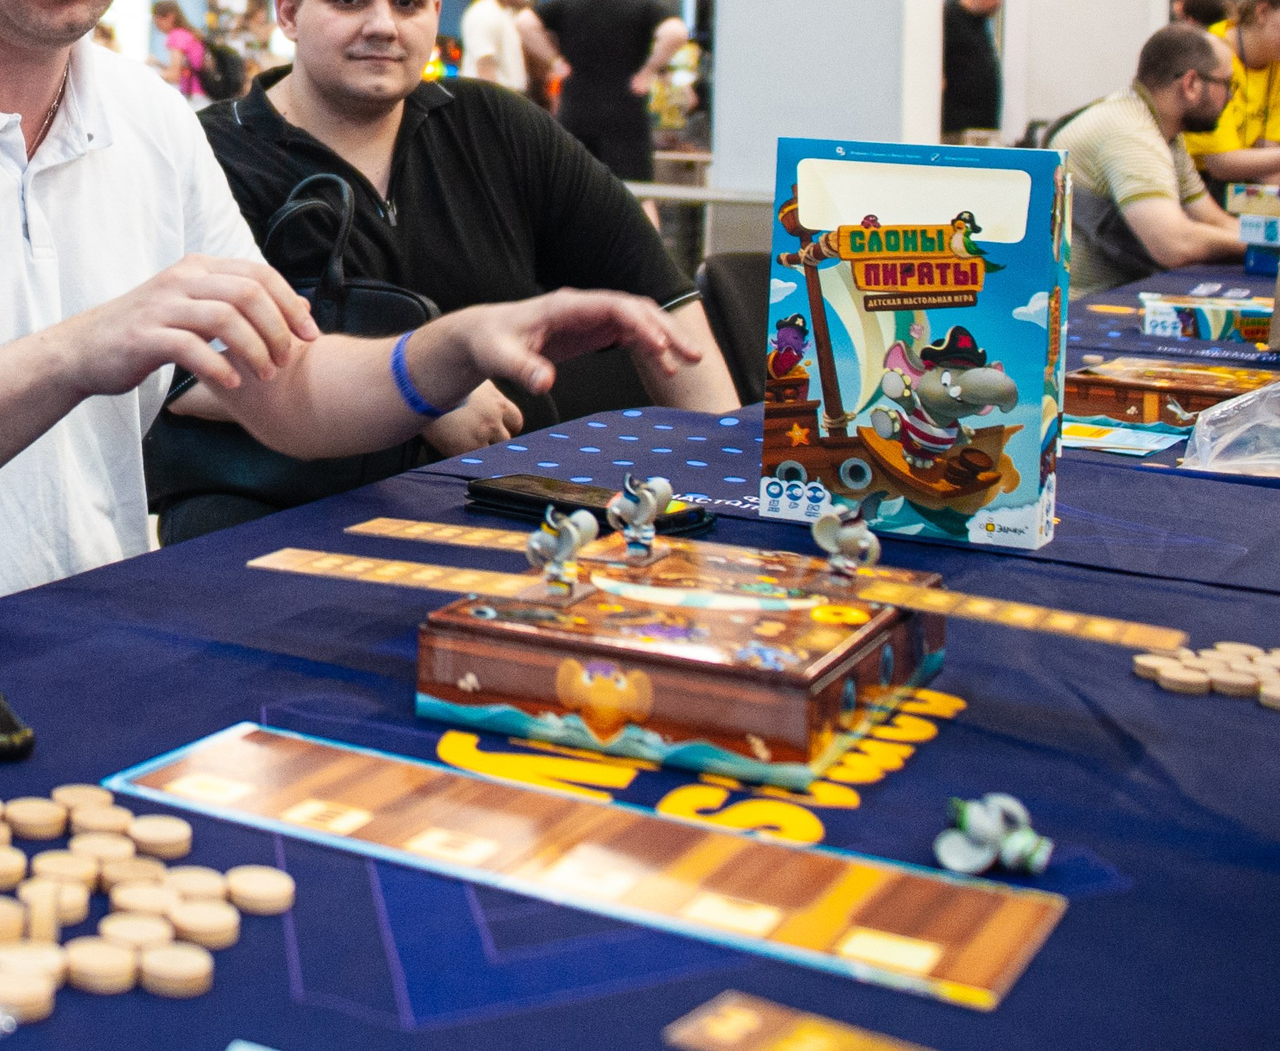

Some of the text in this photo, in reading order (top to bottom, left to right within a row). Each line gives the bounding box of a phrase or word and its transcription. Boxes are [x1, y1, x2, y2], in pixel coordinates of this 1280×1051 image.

[849, 229, 945, 253] СЛОНЫ
[864, 262, 979, 286] ПИРАТЫ
[867, 294, 974, 308] ДЕТСКАЯ НАСТОЛЬНАЯ ИГРА
